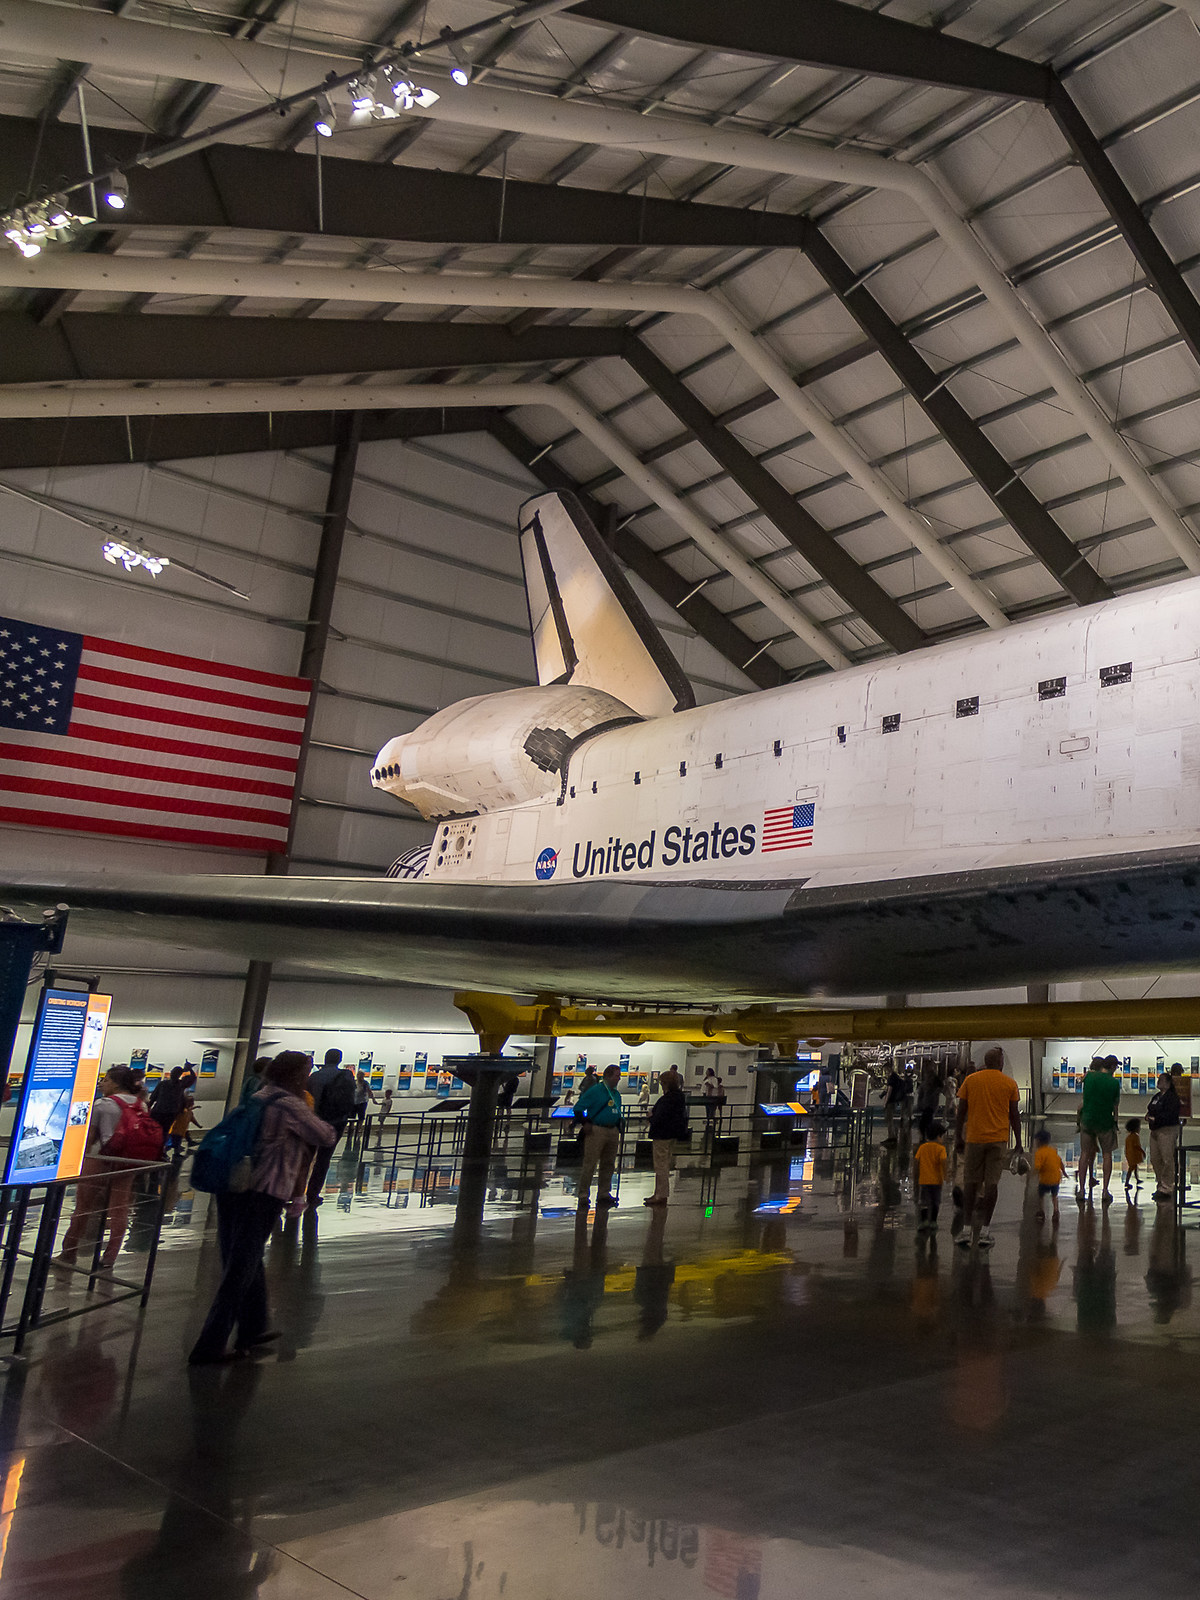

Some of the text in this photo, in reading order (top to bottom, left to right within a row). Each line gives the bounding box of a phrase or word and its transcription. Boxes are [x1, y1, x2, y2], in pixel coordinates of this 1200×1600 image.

[536, 859, 557, 870] NASA
[572, 821, 756, 878] United States
